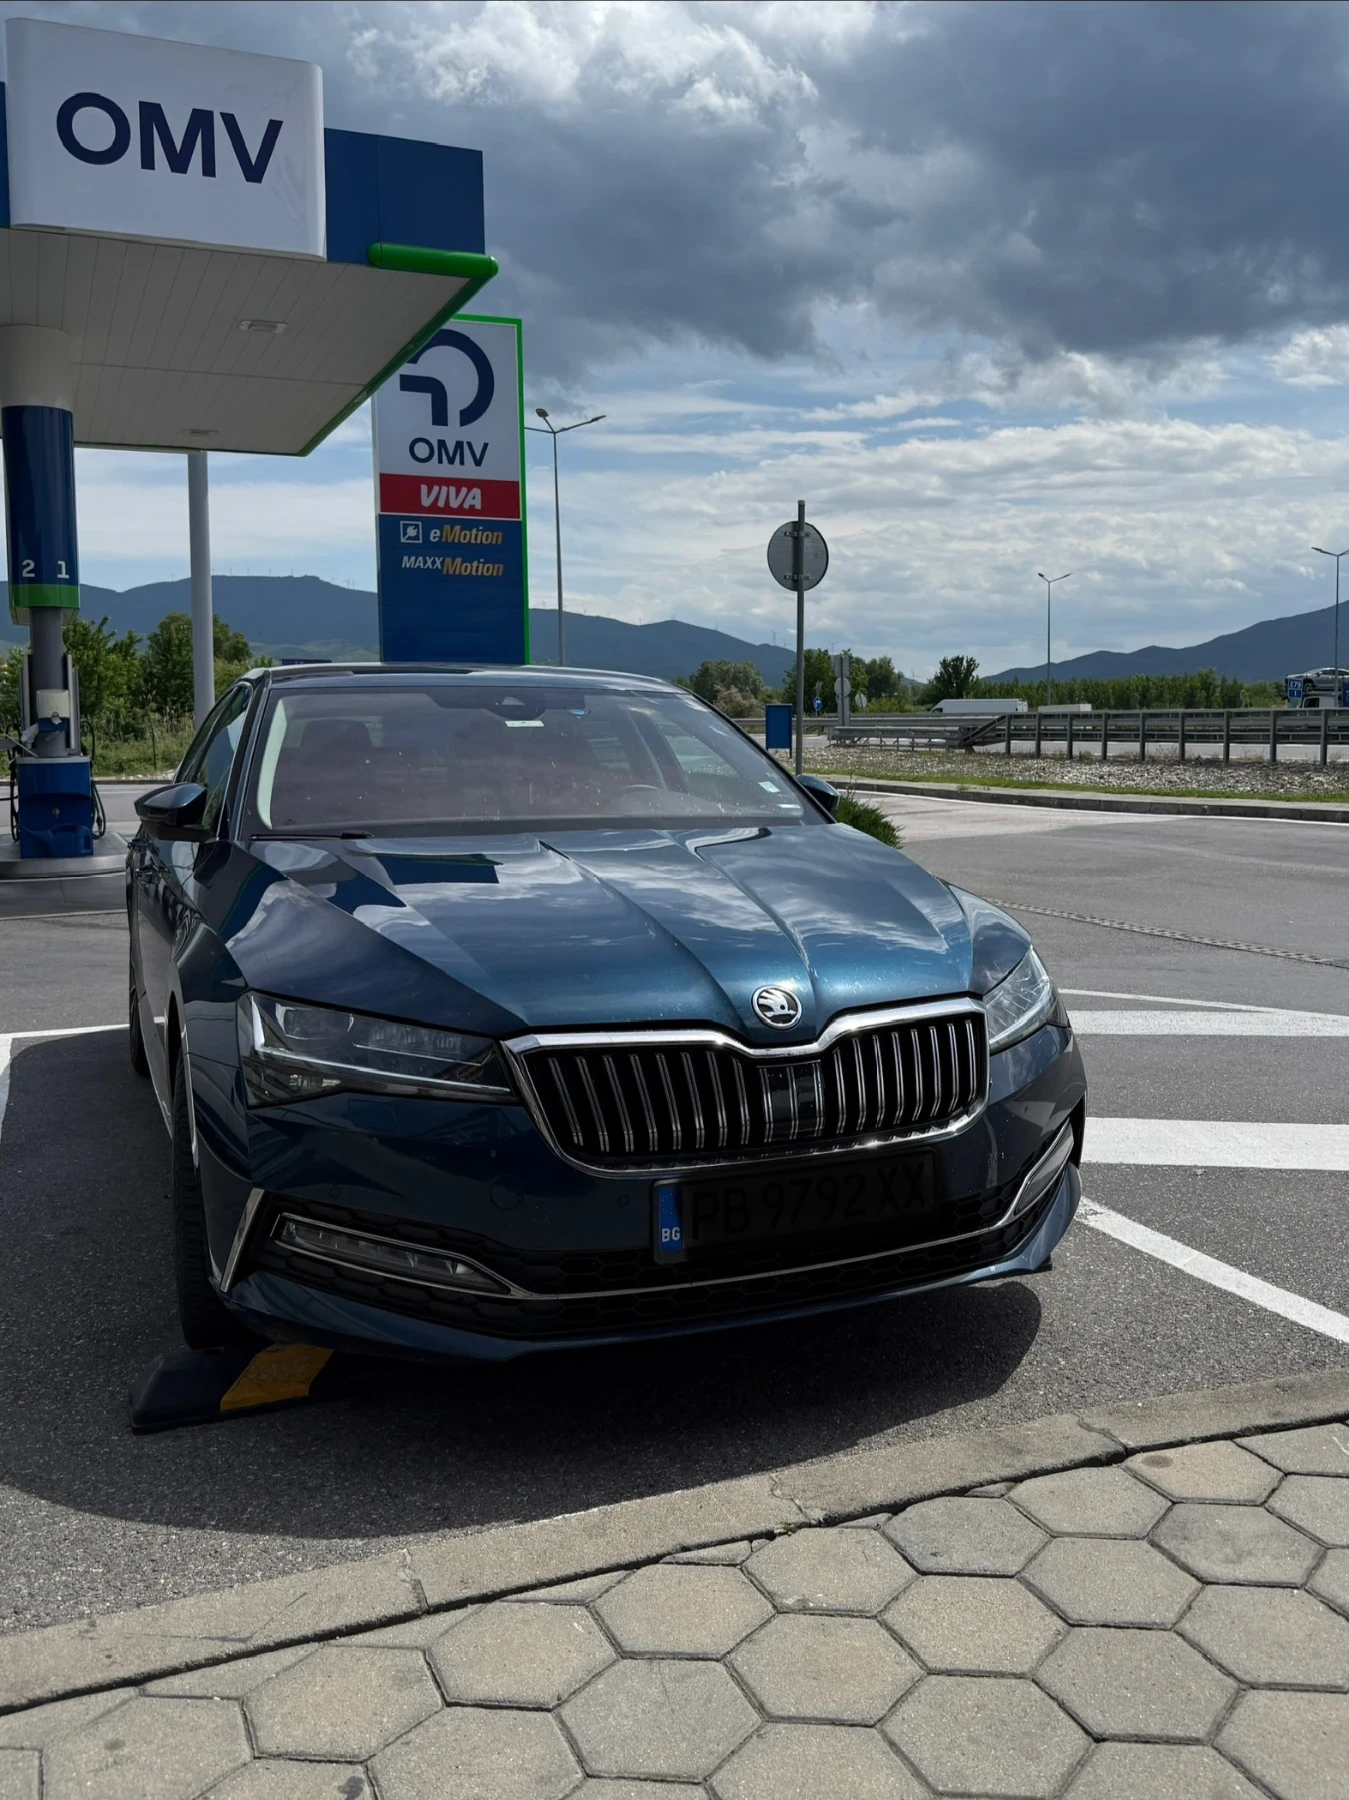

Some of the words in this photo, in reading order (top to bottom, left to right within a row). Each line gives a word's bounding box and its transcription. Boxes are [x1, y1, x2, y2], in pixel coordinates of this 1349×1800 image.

[56, 92, 284, 184] OMV
[409, 437, 489, 467] OMV
[420, 483, 482, 510] VIVA
[22, 559, 35, 577] 2
[57, 560, 70, 579] 1
[691, 1186, 751, 1240] PB
[761, 1172, 867, 1229] 9792
[877, 1161, 926, 1214] XX
[661, 1226, 681, 1242] BG
[255, 1356, 312, 1382] STOP
